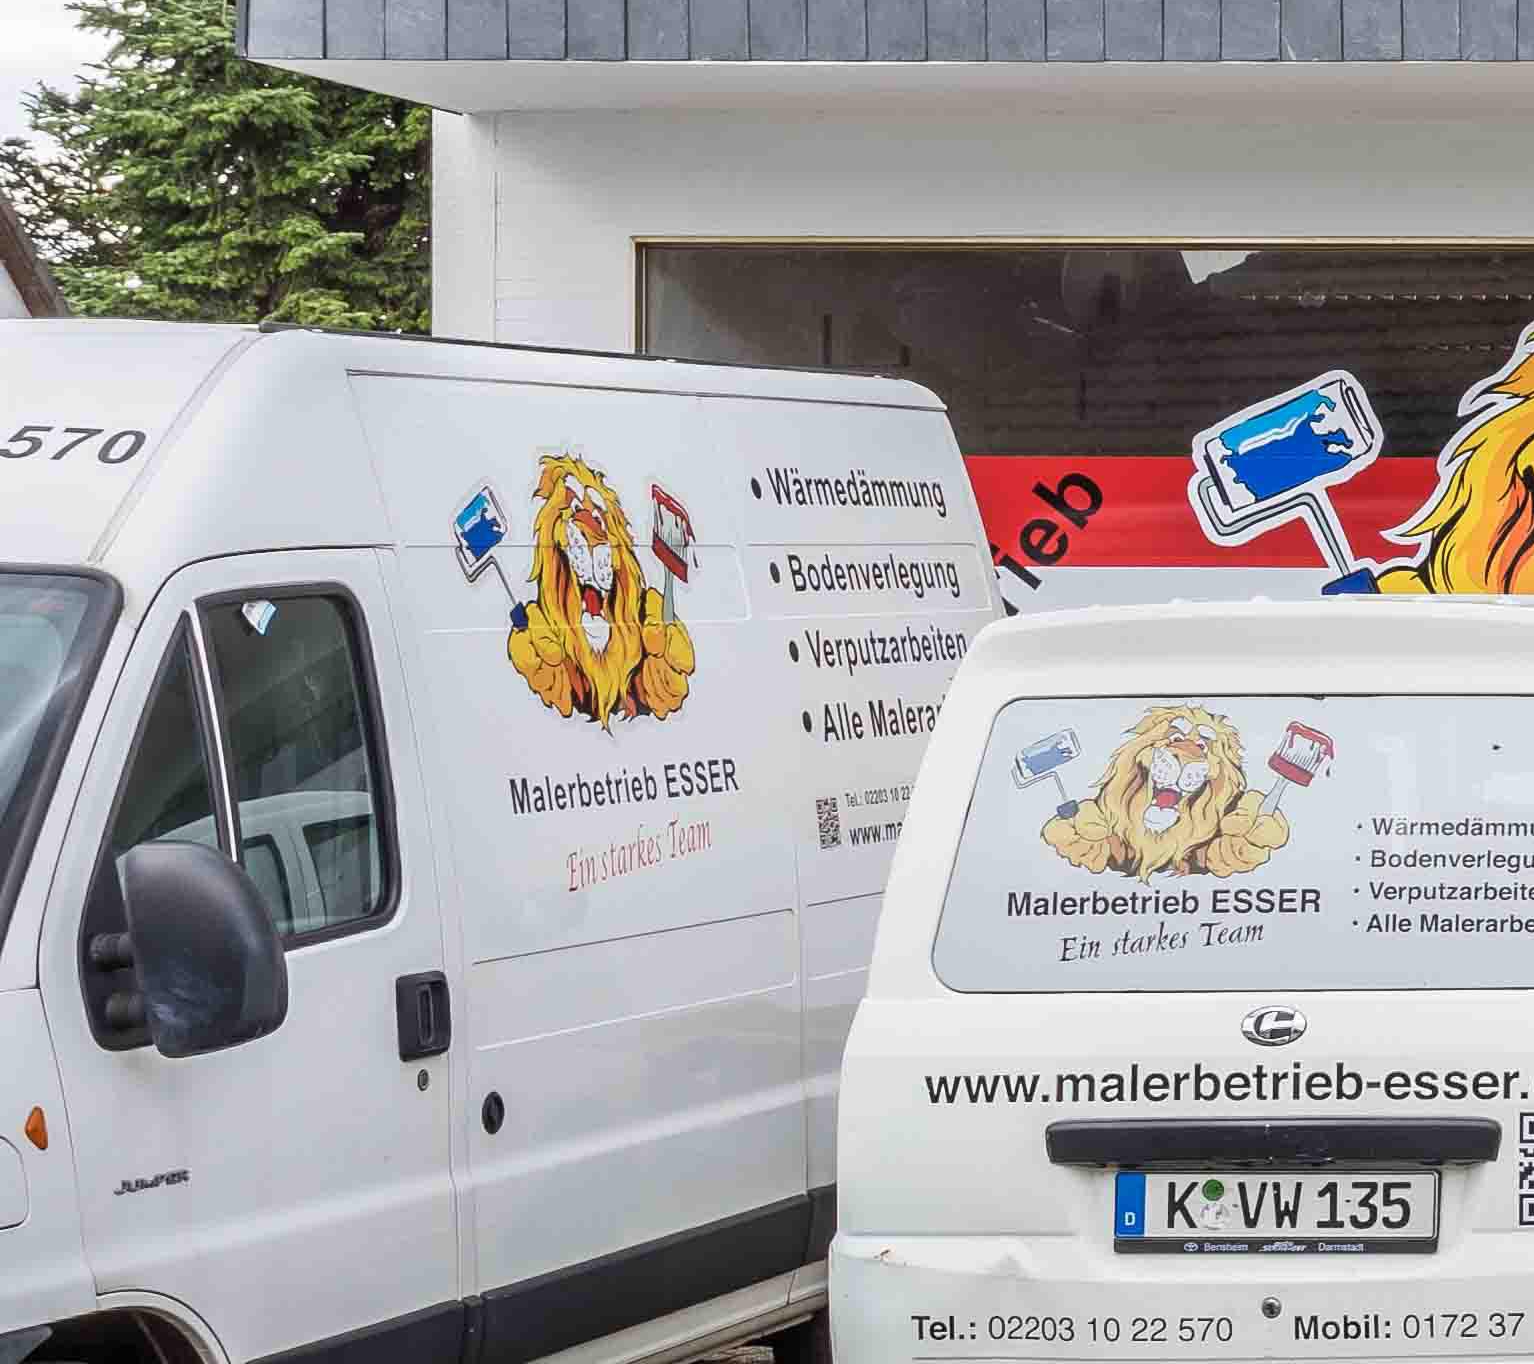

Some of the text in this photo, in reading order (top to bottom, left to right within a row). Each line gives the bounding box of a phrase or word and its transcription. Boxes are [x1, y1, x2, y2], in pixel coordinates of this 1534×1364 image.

[0, 425, 147, 464] 570
[766, 468, 947, 518] Wärmedämmung
[788, 554, 960, 597] Bodenverlegung
[805, 624, 967, 676] Verputzarbeiten
[823, 703, 863, 742] Alle
[509, 758, 740, 815] Malerbetrieb ESSER
[566, 818, 712, 892] Ein starkes Team
[1006, 888, 1321, 917] Malerbetrieb ESSER
[1057, 922, 1265, 963] Ein starkes Team
[1366, 913, 1411, 934] Alle
[1124, 1212, 1137, 1226] D
[1167, 1181, 1412, 1230] K VW 135
[911, 1314, 977, 1342] Tel.:
[988, 1315, 1075, 1342] 02203
[1089, 1316, 1121, 1343] 10
[1130, 1316, 1170, 1343] 22
[1178, 1315, 1234, 1343] 570
[1293, 1312, 1392, 1342] Mobil:
[1402, 1310, 1478, 1339] 0172
[1488, 1310, 1525, 1338] 37
